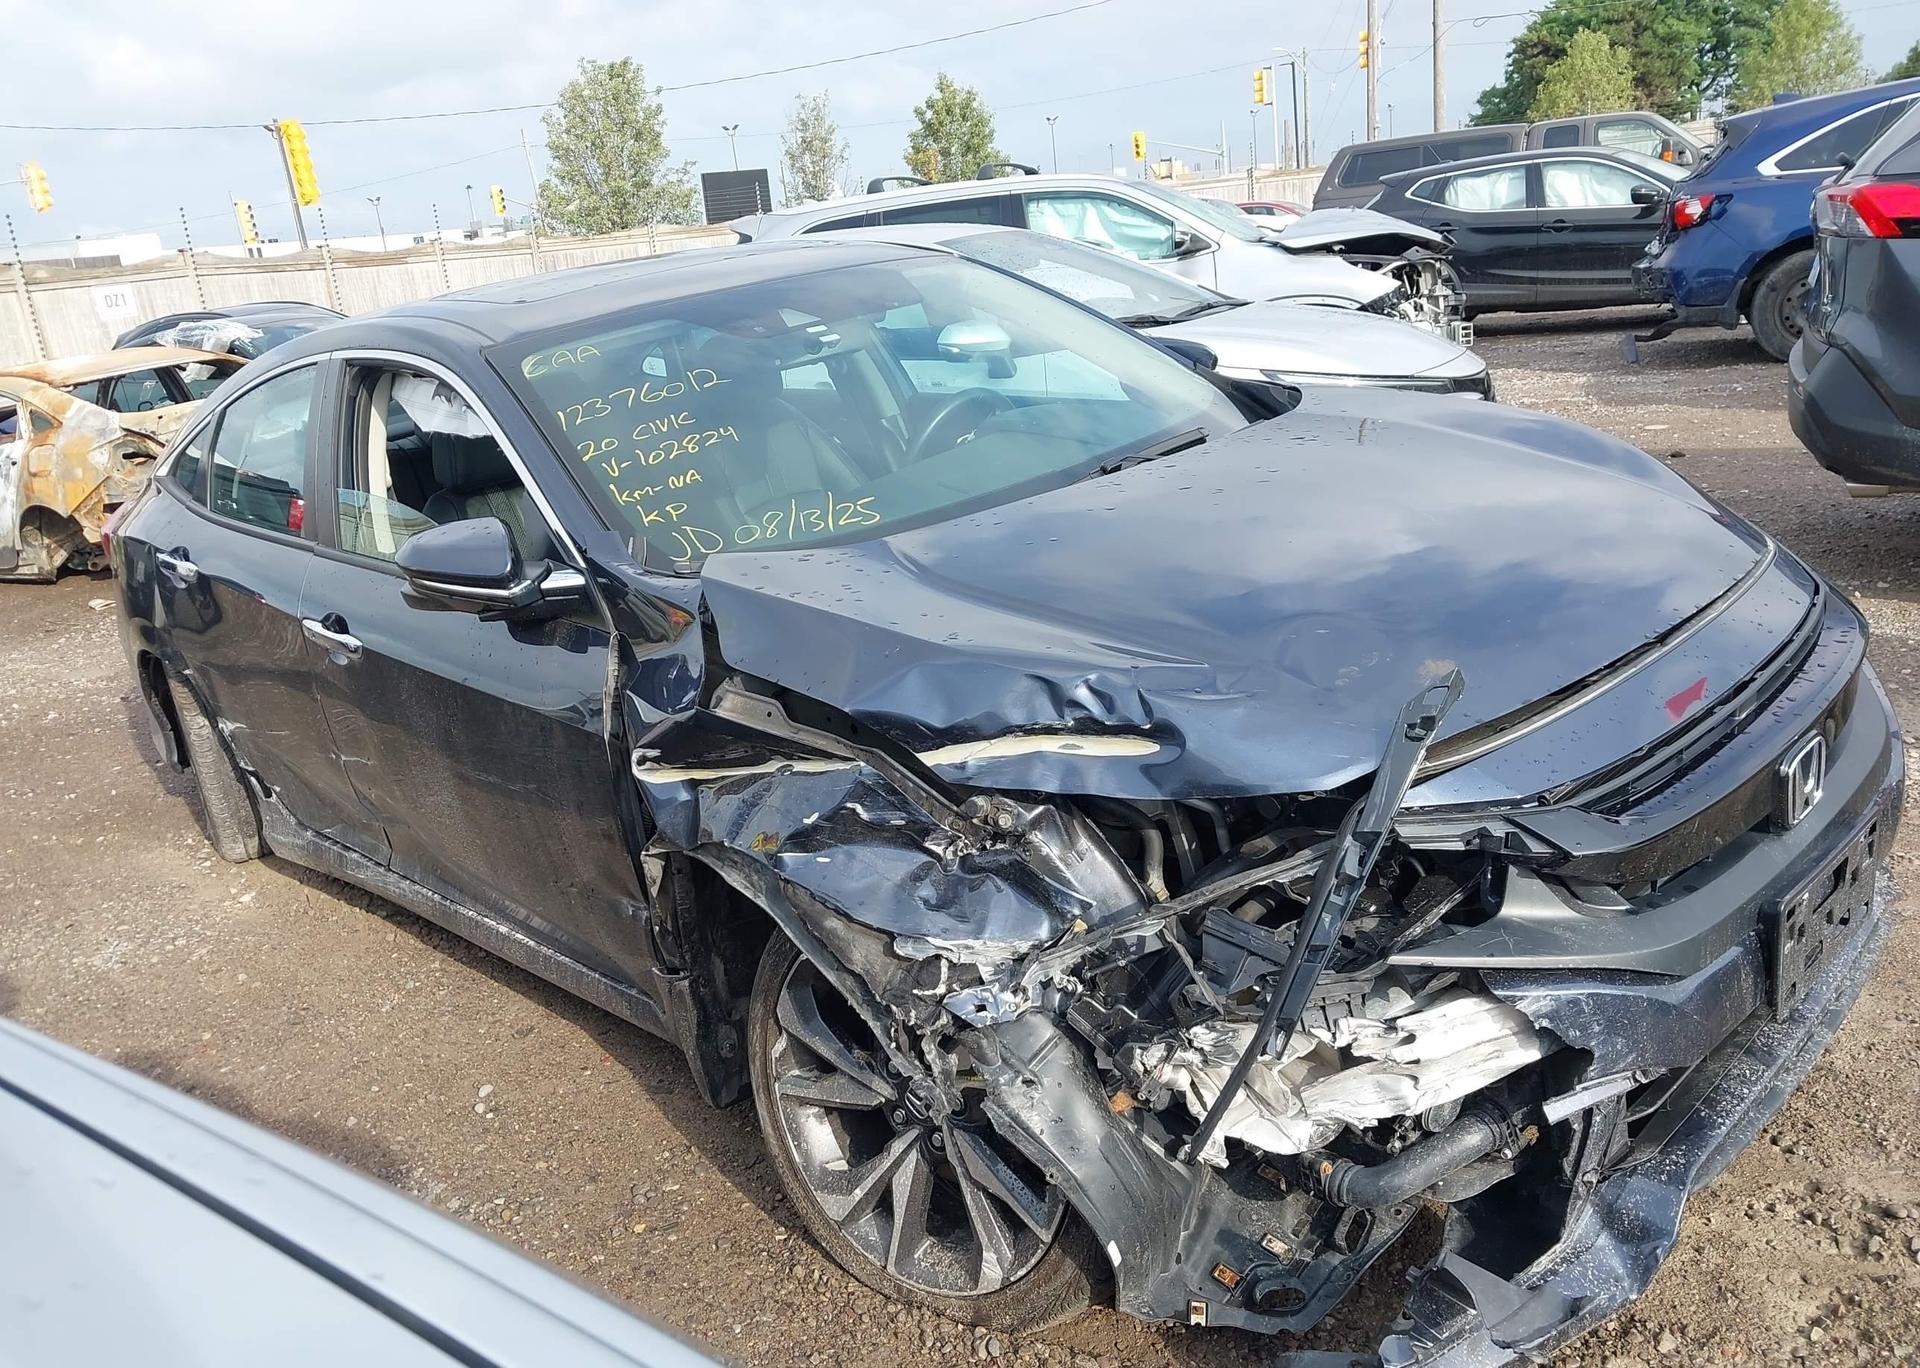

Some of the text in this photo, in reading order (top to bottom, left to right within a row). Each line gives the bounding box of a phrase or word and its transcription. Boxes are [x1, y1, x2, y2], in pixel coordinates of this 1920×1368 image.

[557, 369, 732, 431] 12376012
[576, 412, 696, 462] 20 CIVIC
[669, 491, 880, 561] JD 08/13/25
